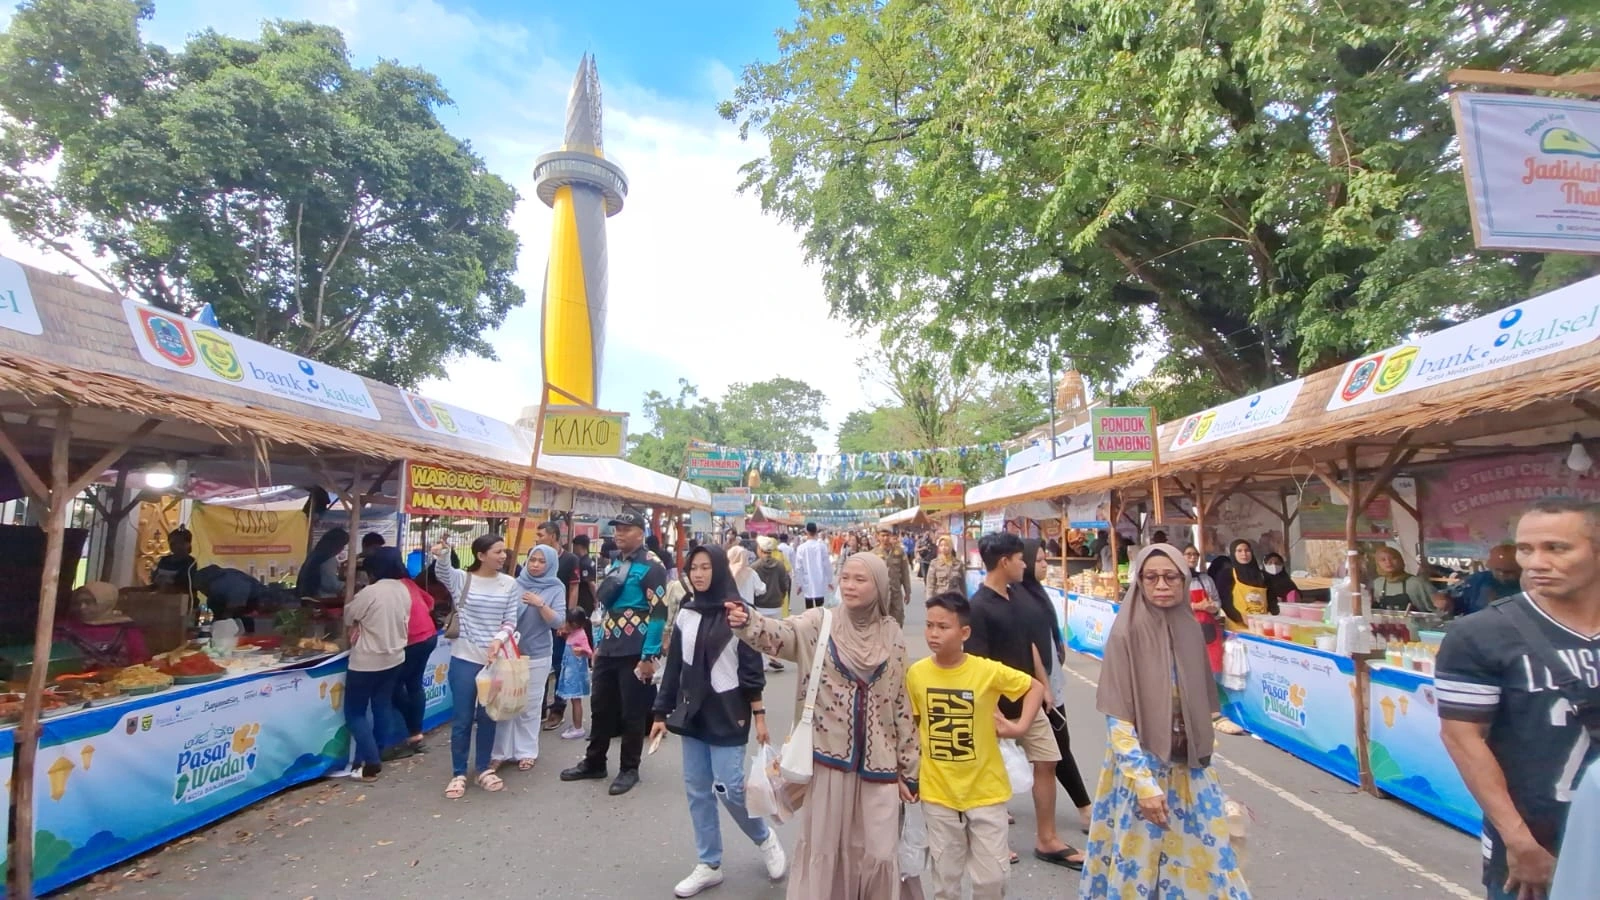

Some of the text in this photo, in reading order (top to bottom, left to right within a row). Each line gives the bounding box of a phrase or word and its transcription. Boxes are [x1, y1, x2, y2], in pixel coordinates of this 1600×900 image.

[1417, 305, 1599, 376] bank kalsel
[248, 361, 304, 391] bank
[321, 382, 371, 409] kalsel
[553, 418, 610, 446] KAKO
[1101, 416, 1146, 433] PONDOK
[1097, 435, 1152, 451] KAMBING
[411, 465, 484, 491] WAROENG
[1453, 478, 1469, 493] ES
[1471, 465, 1516, 485] TELER
[412, 492, 522, 513] MASAKAN BANJAR
[1452, 500, 1468, 515] ES
[1469, 488, 1511, 507] KRIM
[1262, 680, 1288, 701] Pasar
[1270, 697, 1299, 722] Wadai
[177, 741, 231, 775] Pasar
[191, 753, 245, 790] Wadai
